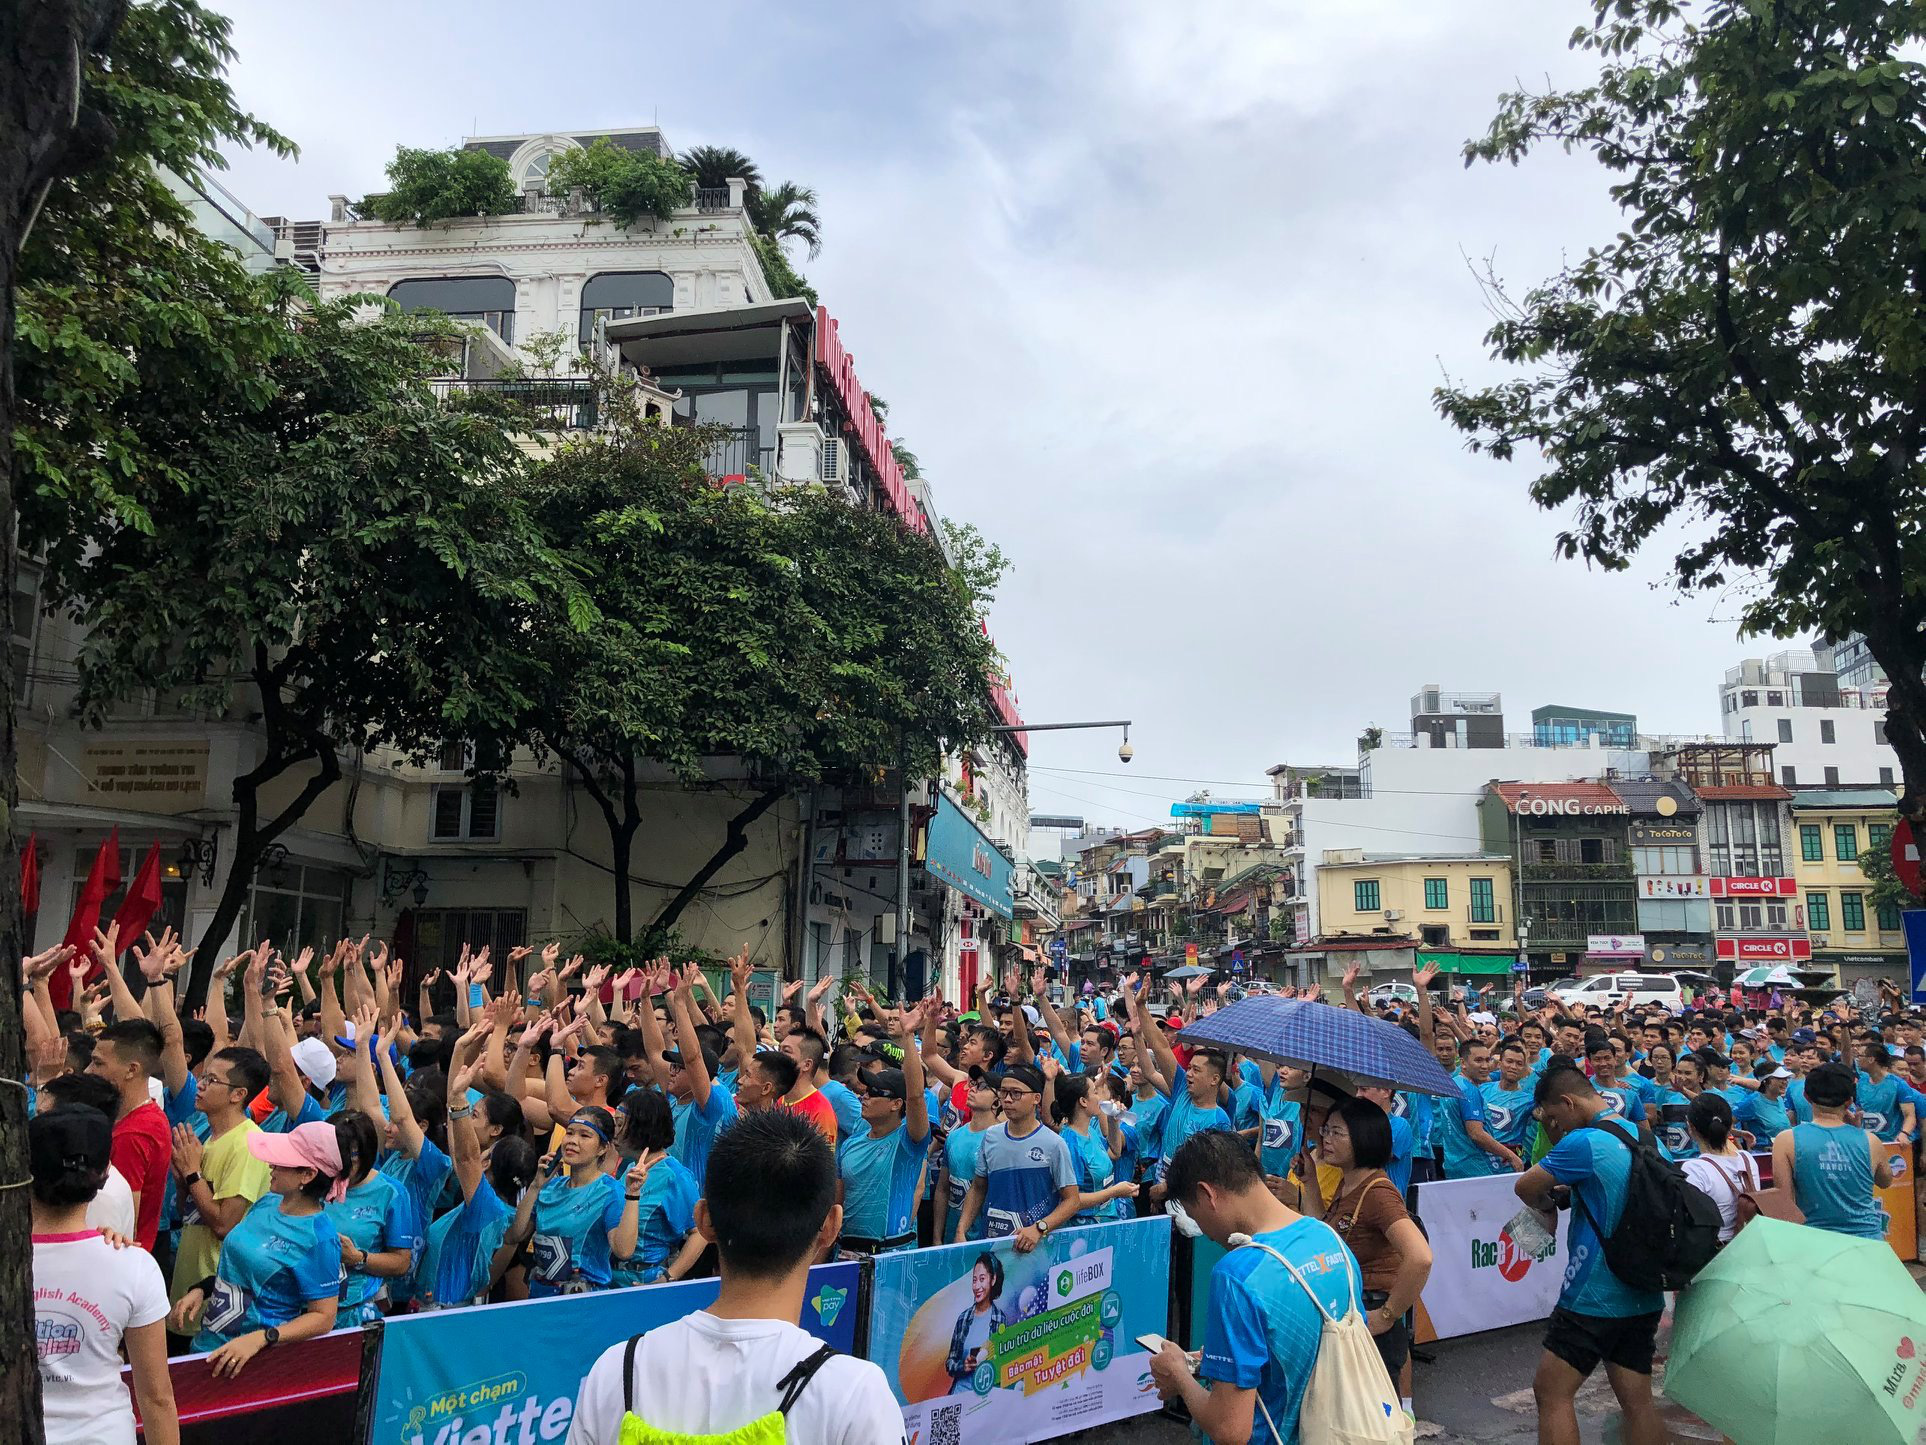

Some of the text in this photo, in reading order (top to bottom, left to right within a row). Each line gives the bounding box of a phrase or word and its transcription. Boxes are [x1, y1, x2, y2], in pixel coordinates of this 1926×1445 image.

[1730, 881, 1772, 891] CIRCLE K
[1774, 943, 1785, 953] K
[1075, 1262, 1105, 1286] lifeBOX
[33, 1287, 112, 1332] glish Academy
[822, 1301, 840, 1313] pay
[35, 1320, 78, 1339] tion
[999, 1336, 1015, 1355] Lưu
[1043, 1319, 1059, 1336] liệu
[1060, 1311, 1080, 1327] cuộc
[36, 1338, 80, 1360] glish
[1007, 1353, 1043, 1379] Bảo mật
[1034, 1346, 1085, 1385] Tuyệt đối
[1883, 1362, 1908, 1398] Mưa
[430, 1378, 518, 1417] Một chạm
